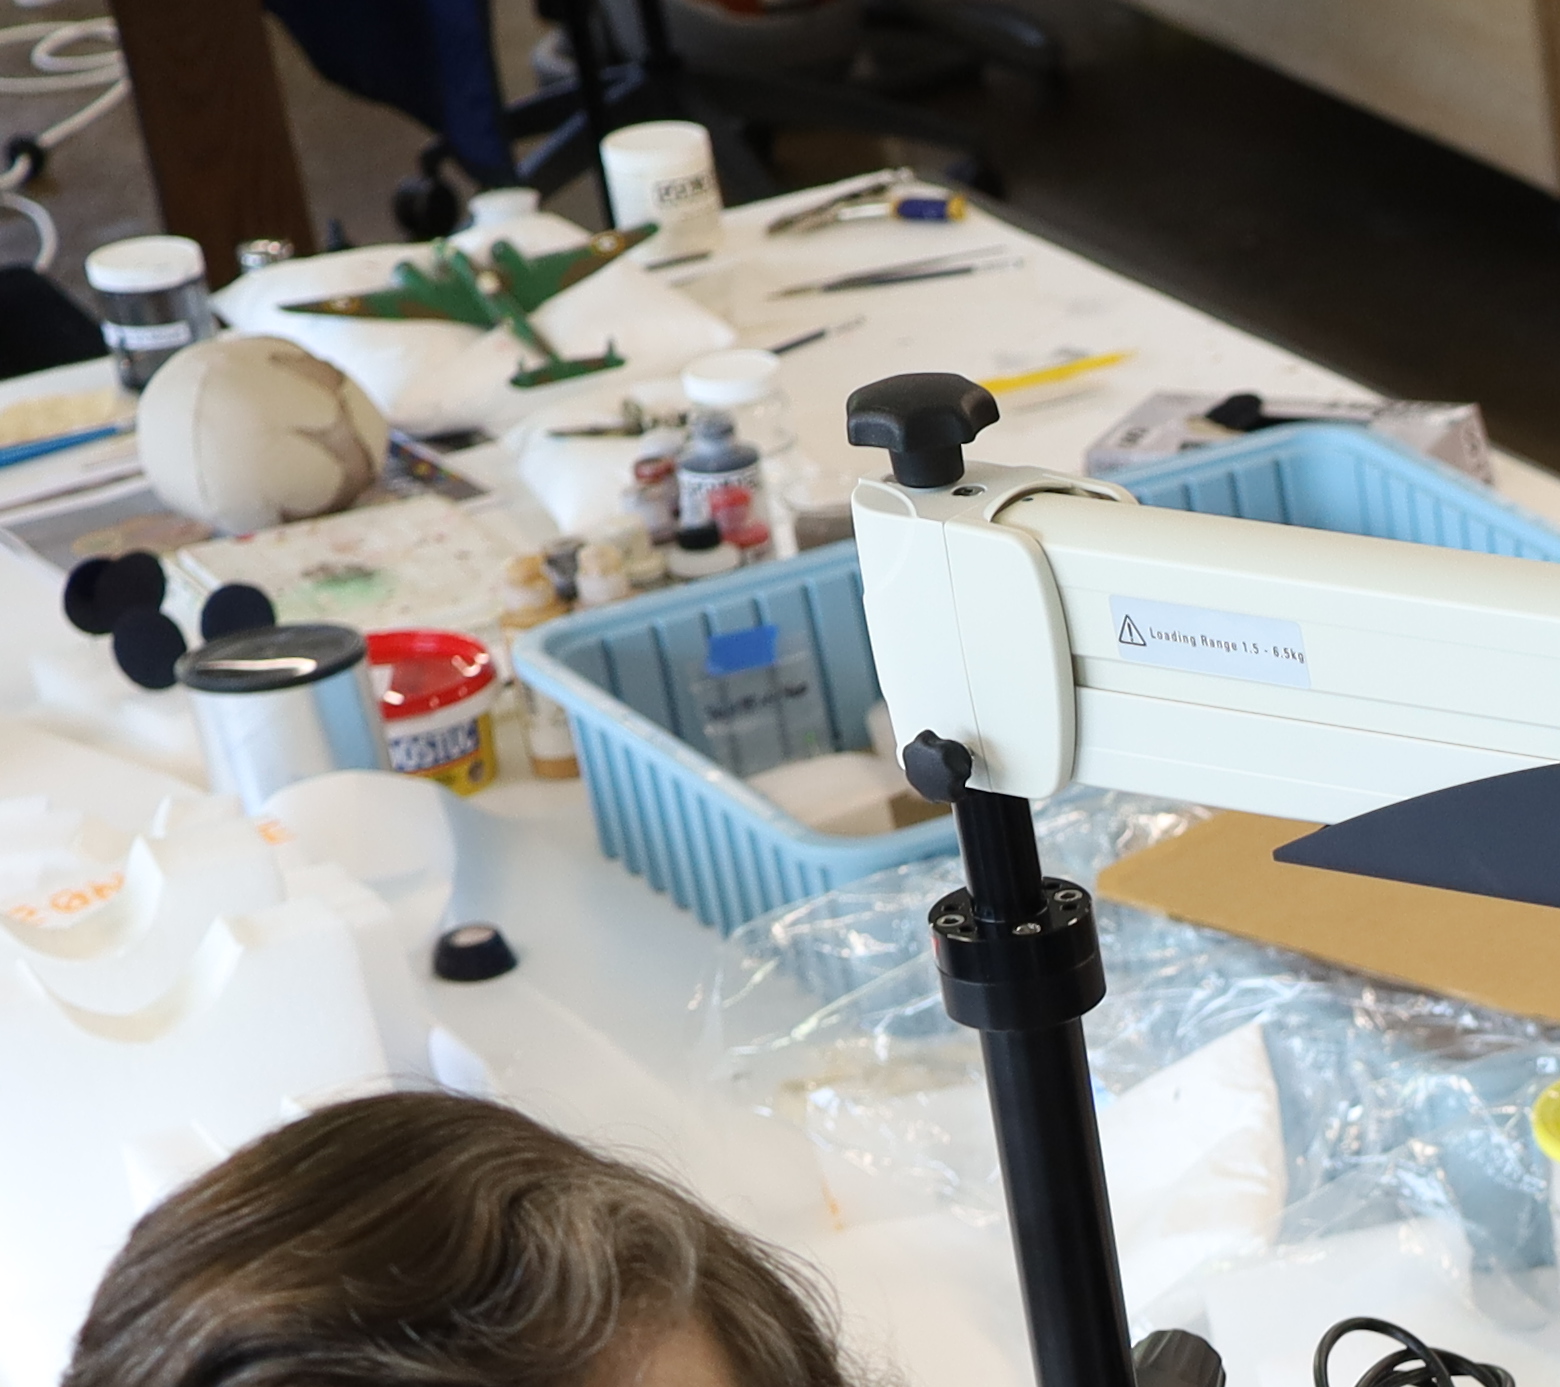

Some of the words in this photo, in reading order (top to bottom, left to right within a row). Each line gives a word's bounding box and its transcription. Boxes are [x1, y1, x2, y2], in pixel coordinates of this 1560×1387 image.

[1149, 627, 1197, 647] Loading
[1201, 635, 1238, 653] Range
[1242, 641, 1260, 655] 1.5
[1273, 646, 1305, 664] 6.5kg
